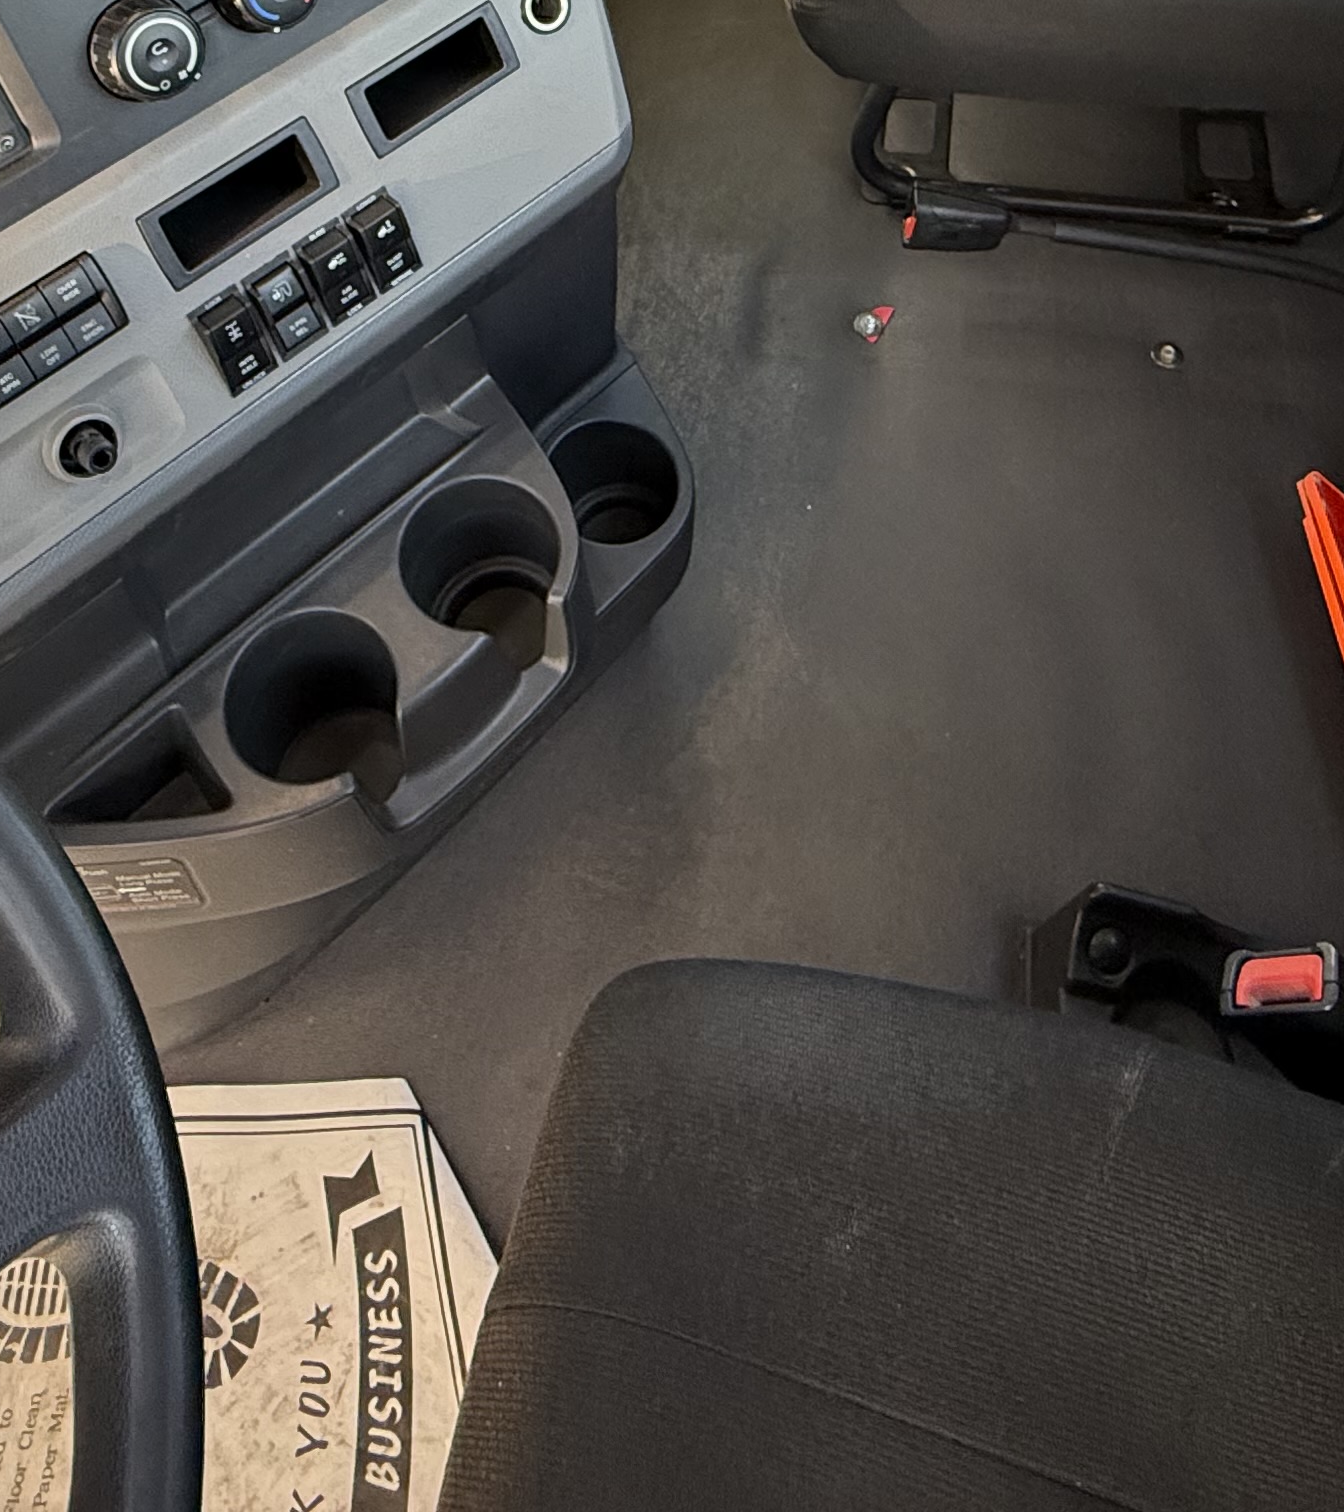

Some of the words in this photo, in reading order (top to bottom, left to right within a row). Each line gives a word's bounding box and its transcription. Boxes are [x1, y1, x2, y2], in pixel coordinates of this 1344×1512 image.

[56, 278, 78, 295] OVER
[0, 372, 14, 386] ATC
[46, 352, 61, 366] OFF
[363, 1248, 404, 1493] BUSINESS
[294, 1359, 333, 1459] YOU
[31, 1443, 58, 1511] Paper
